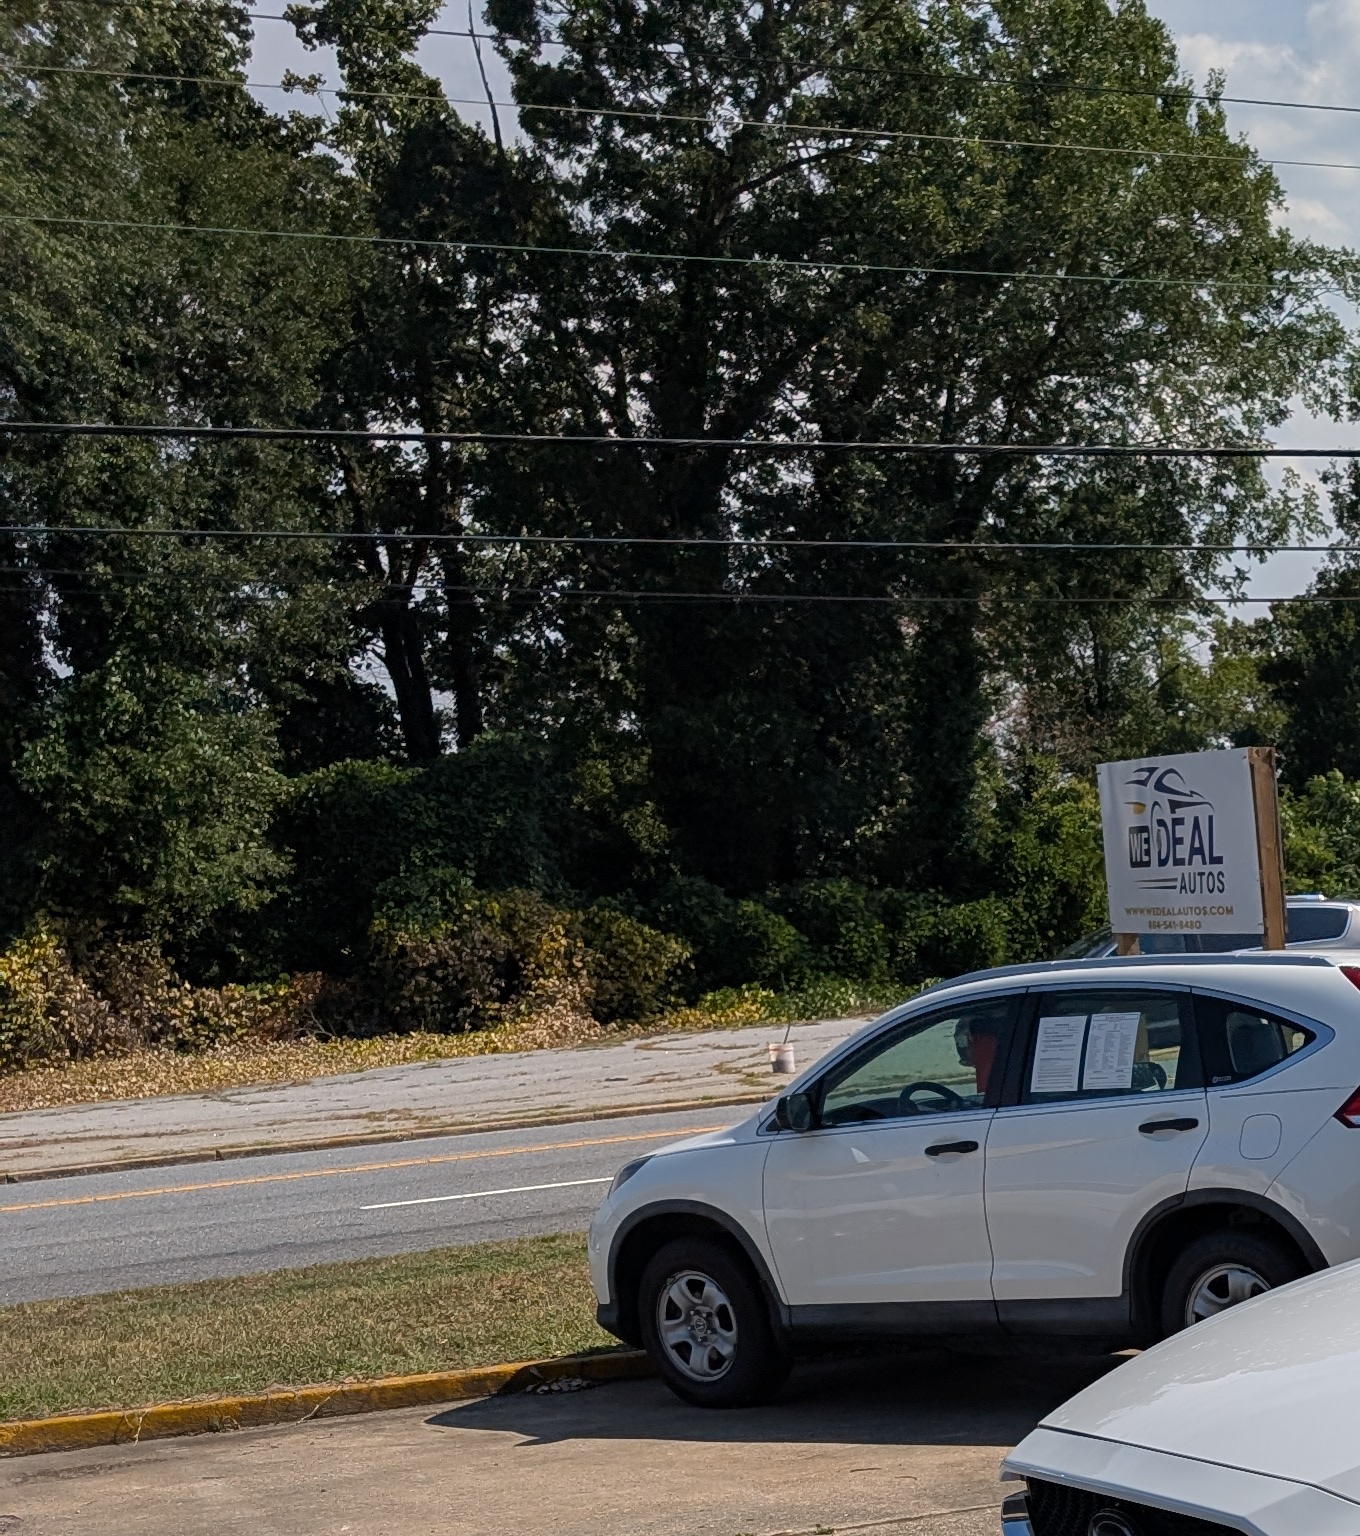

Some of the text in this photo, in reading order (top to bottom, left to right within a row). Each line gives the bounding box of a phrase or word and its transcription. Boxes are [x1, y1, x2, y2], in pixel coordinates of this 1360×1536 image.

[1130, 815, 1224, 868] WE DEAL
[1179, 871, 1225, 894] AUTOS
[1125, 906, 1234, 917] WWWWEDEALAUTOS.COM
